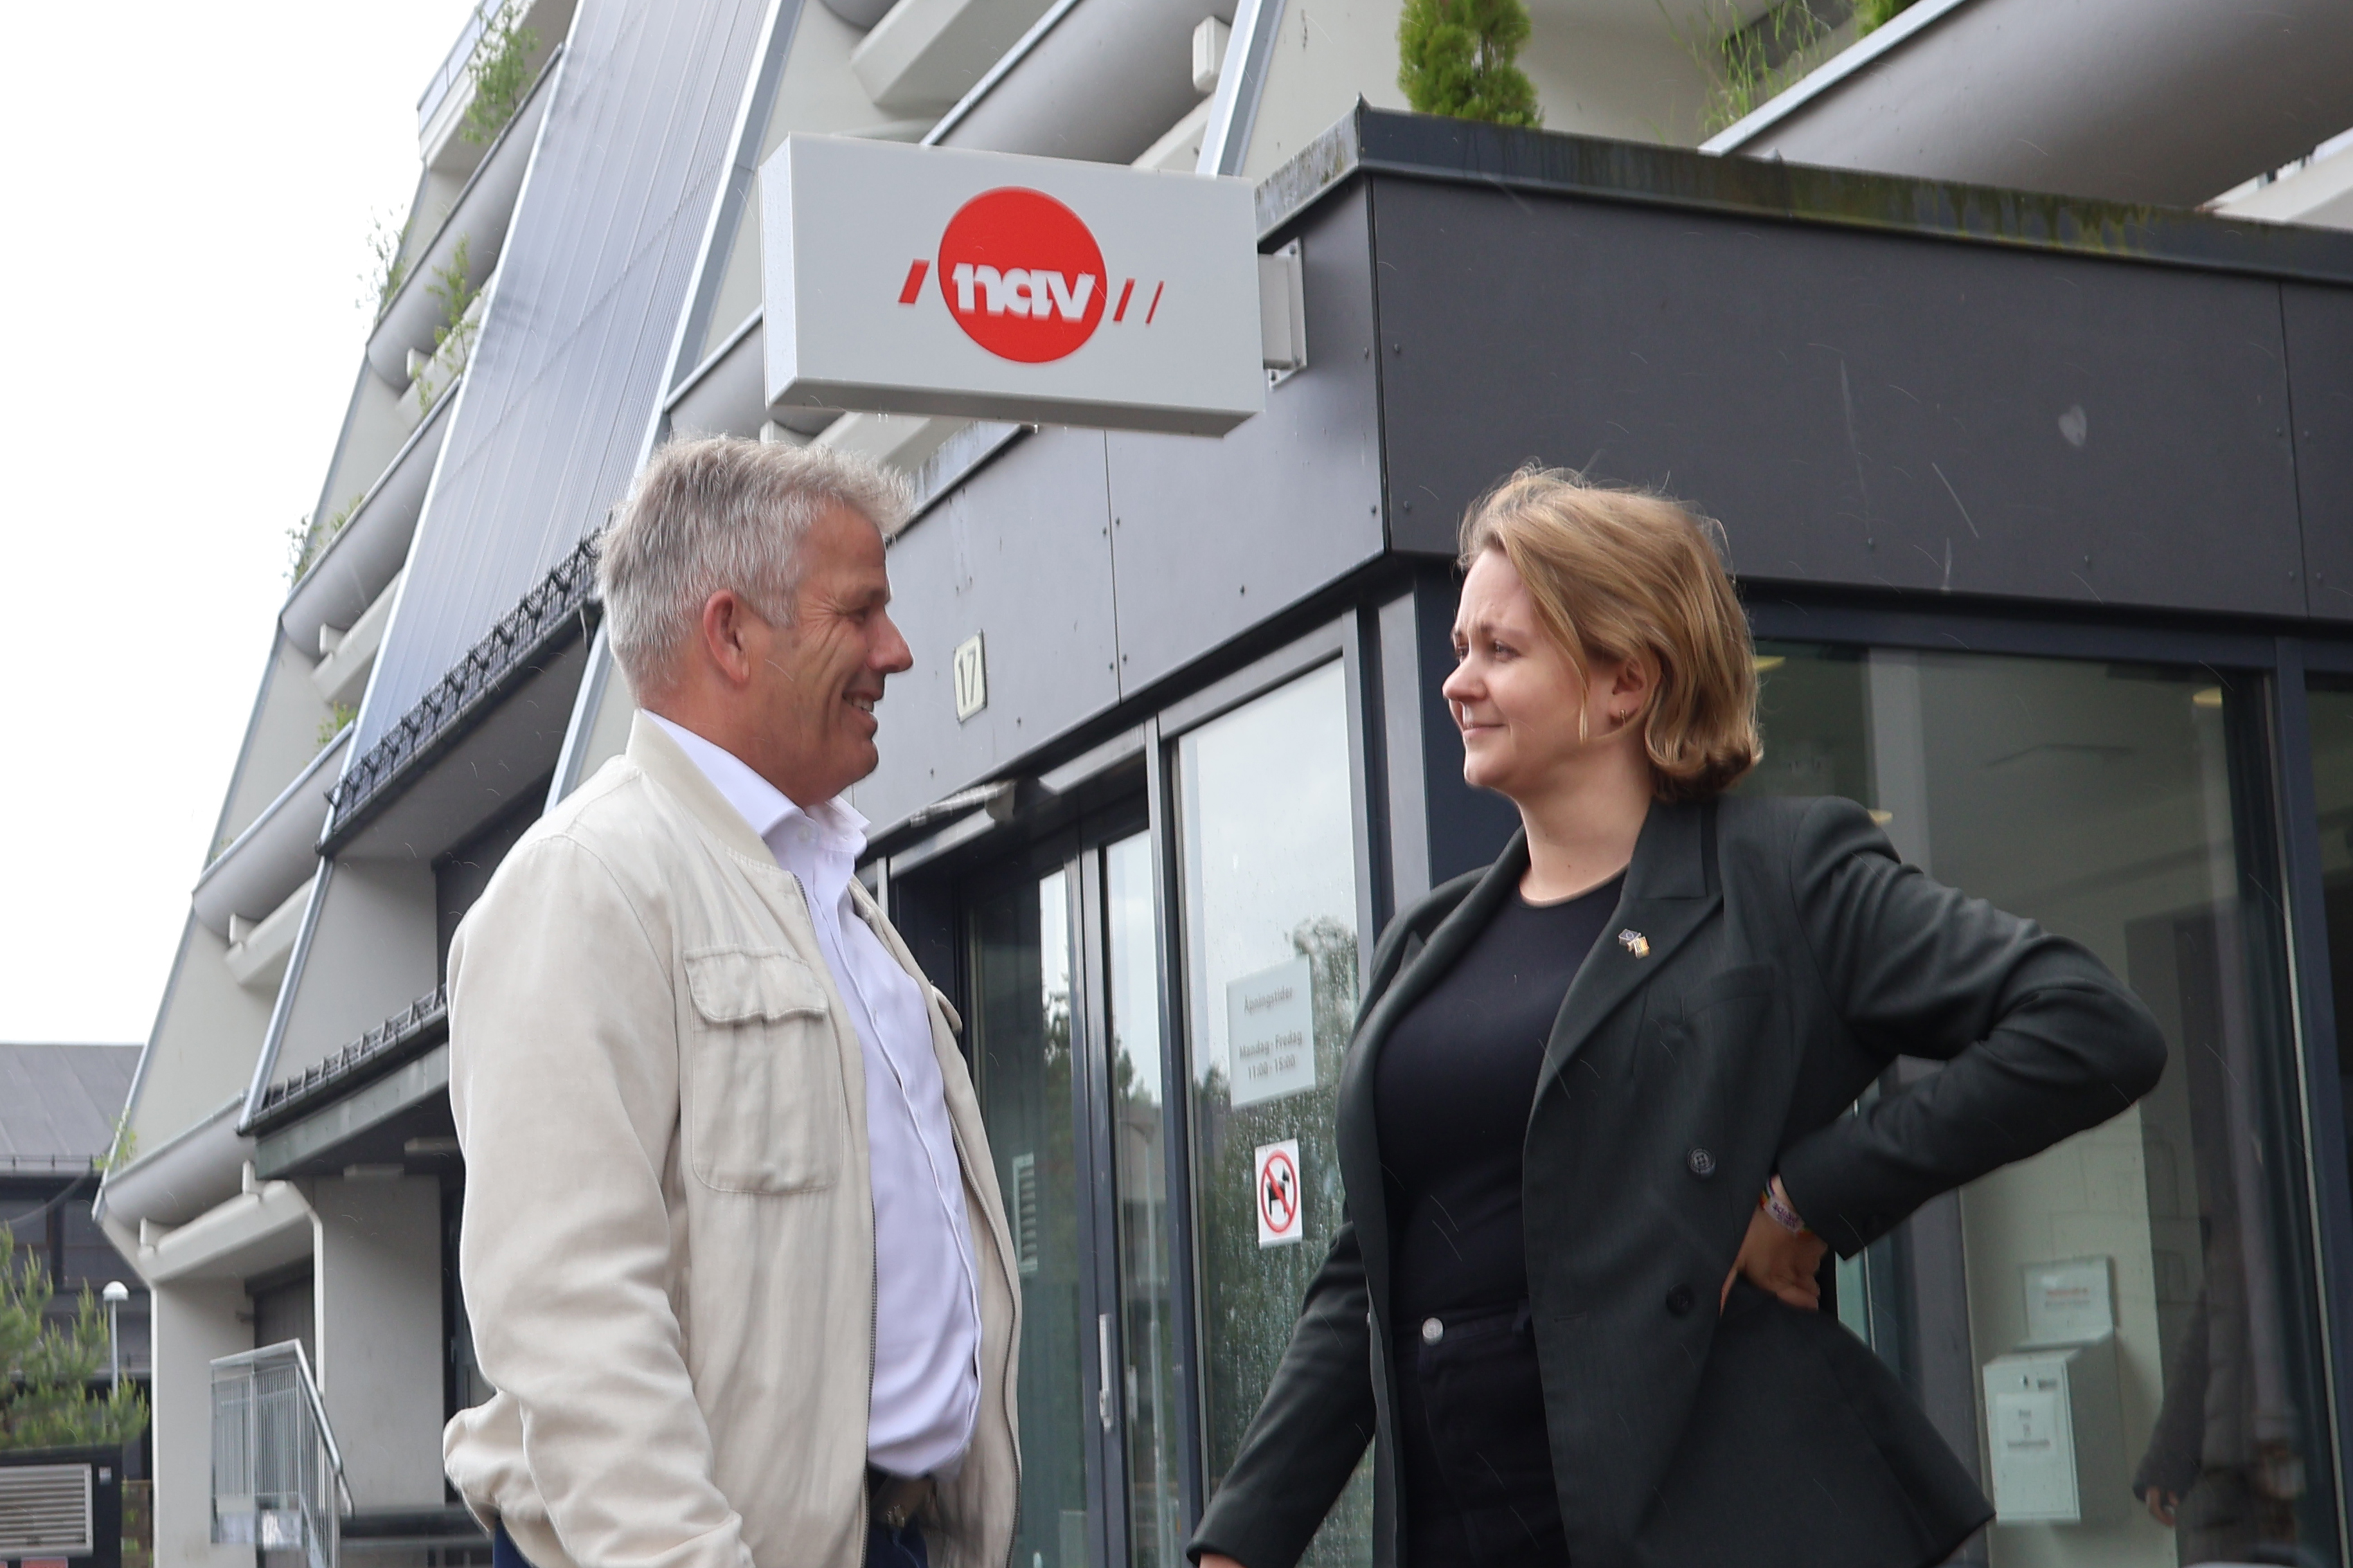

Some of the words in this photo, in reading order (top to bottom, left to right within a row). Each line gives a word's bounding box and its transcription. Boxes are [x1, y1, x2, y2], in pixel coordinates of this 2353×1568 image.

[958, 645, 976, 707] 17
[1244, 985, 1292, 1016] Åpningstider
[1240, 1040, 1269, 1060] Mandag
[1275, 1030, 1302, 1049] Fredag
[1248, 1061, 1268, 1080] 11:00
[1275, 1054, 1296, 1074] 15:00
